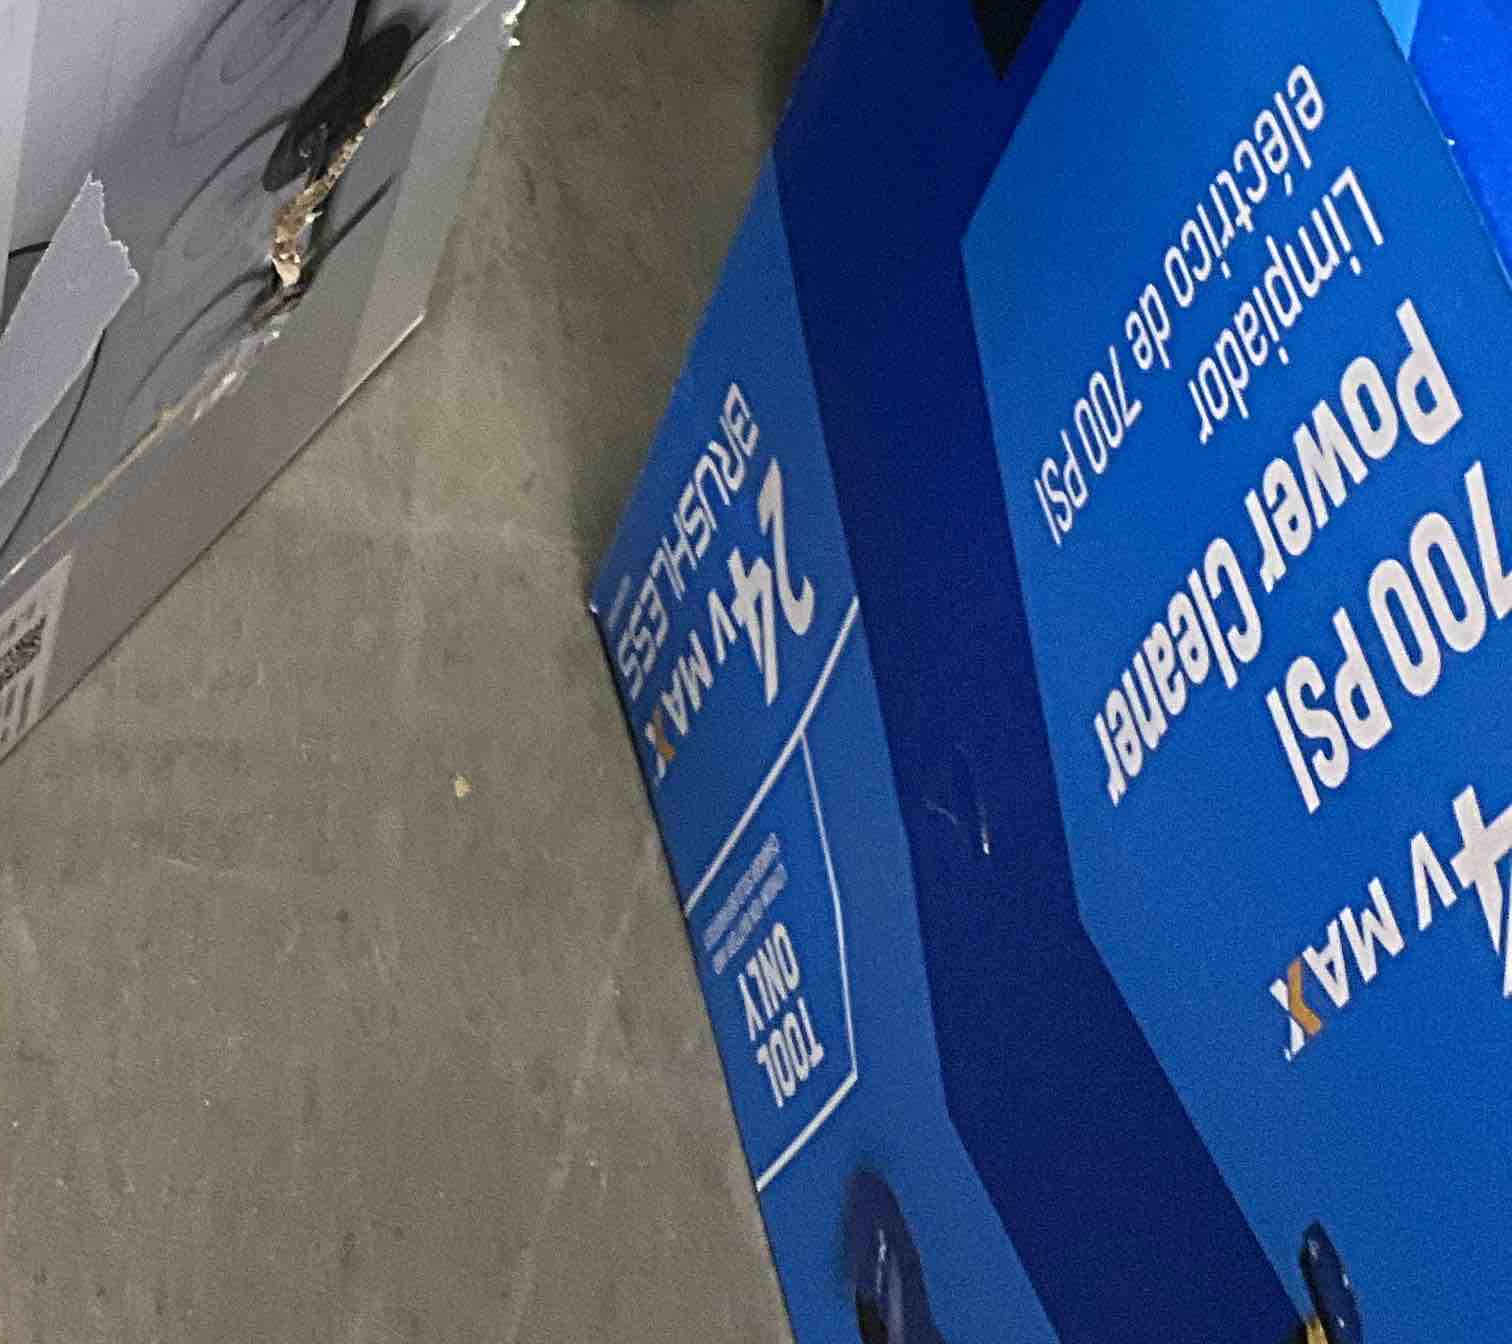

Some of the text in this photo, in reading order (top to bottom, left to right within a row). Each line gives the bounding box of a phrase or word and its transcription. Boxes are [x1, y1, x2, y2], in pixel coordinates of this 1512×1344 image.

[1033, 64, 1326, 548] eléctrico de 700 PSI
[1188, 165, 1385, 445] Limpiador
[620, 381, 761, 702] BRUSHLESS
[1093, 297, 1464, 807] Power Cleaner
[1265, 459, 1512, 815] 700 PSI
[735, 922, 801, 1043] ONLY
[755, 998, 825, 1110] TOOL
[1269, 876, 1406, 1063] MAX
